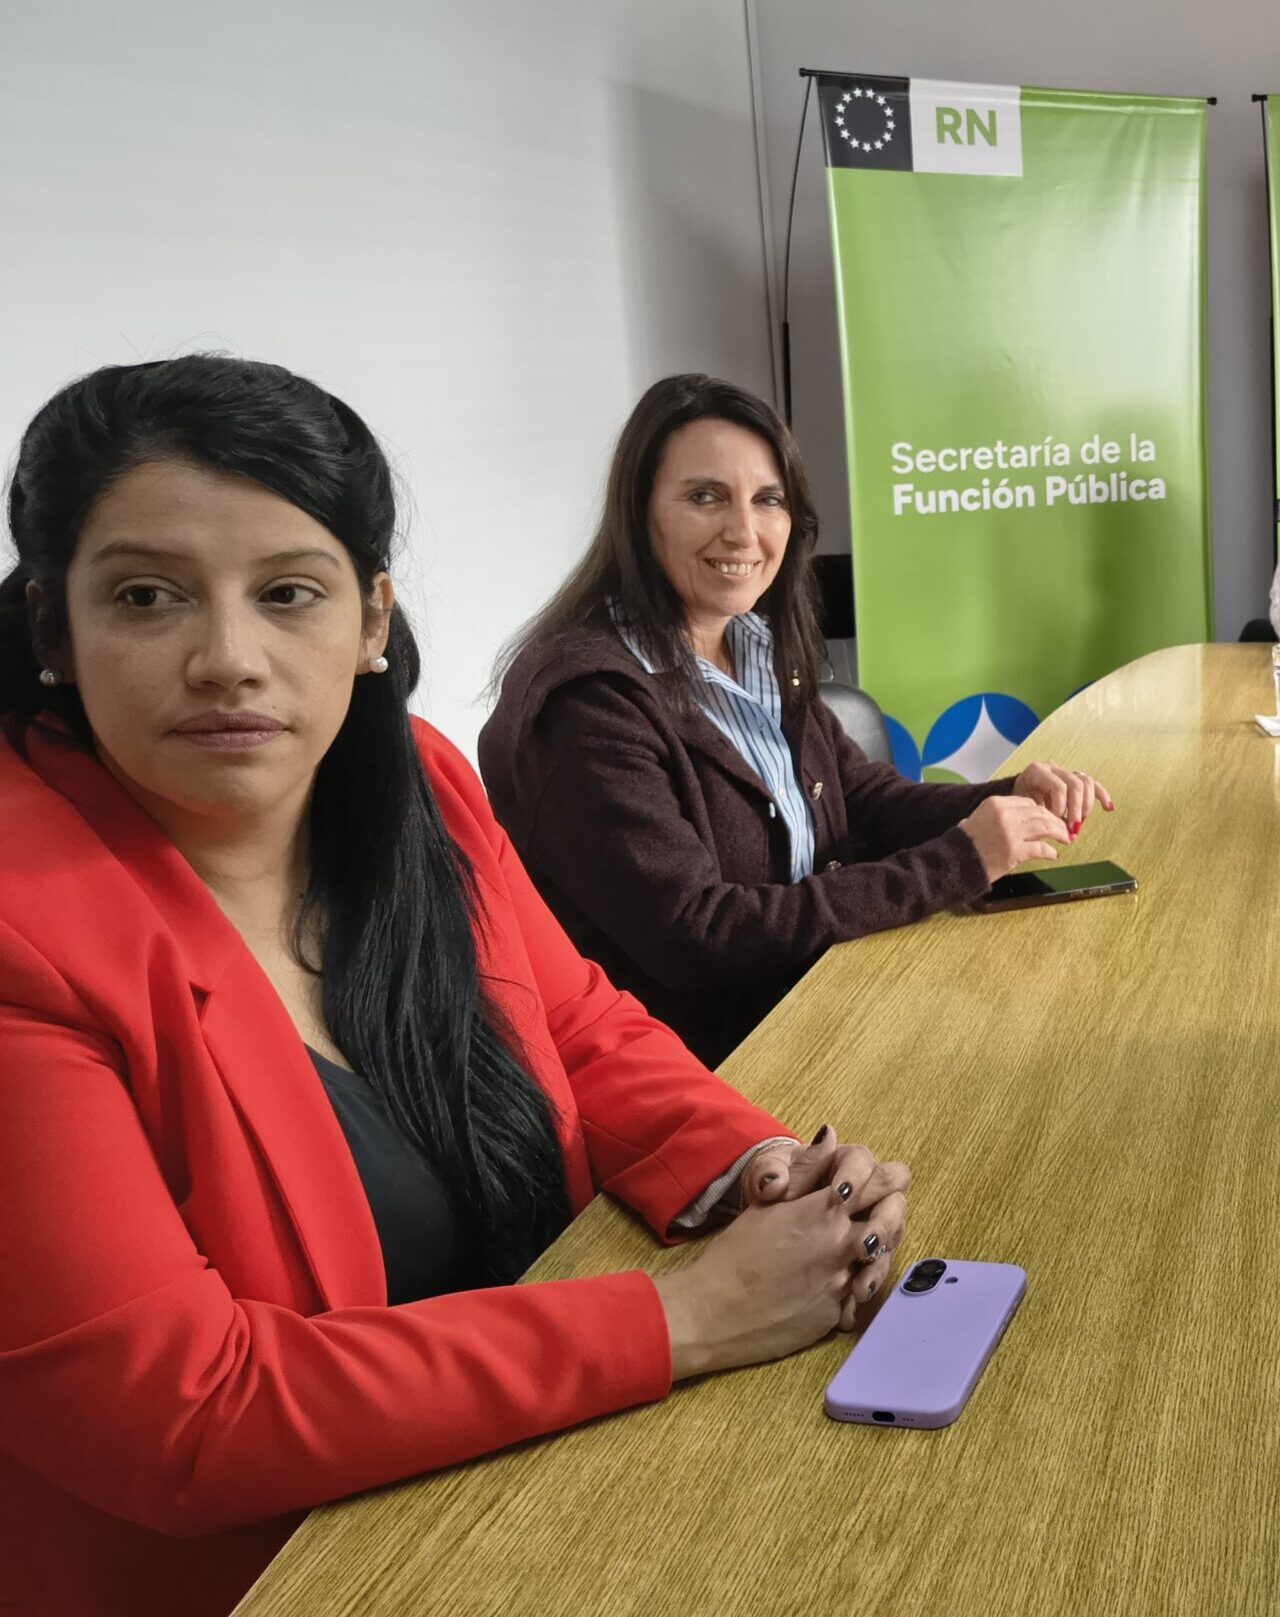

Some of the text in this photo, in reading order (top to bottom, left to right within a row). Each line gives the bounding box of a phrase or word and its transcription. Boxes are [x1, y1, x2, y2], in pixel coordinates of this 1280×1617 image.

[935, 106, 998, 147] RN
[891, 432, 1156, 474] Secretaría de la
[893, 471, 1167, 516] Función Pública
